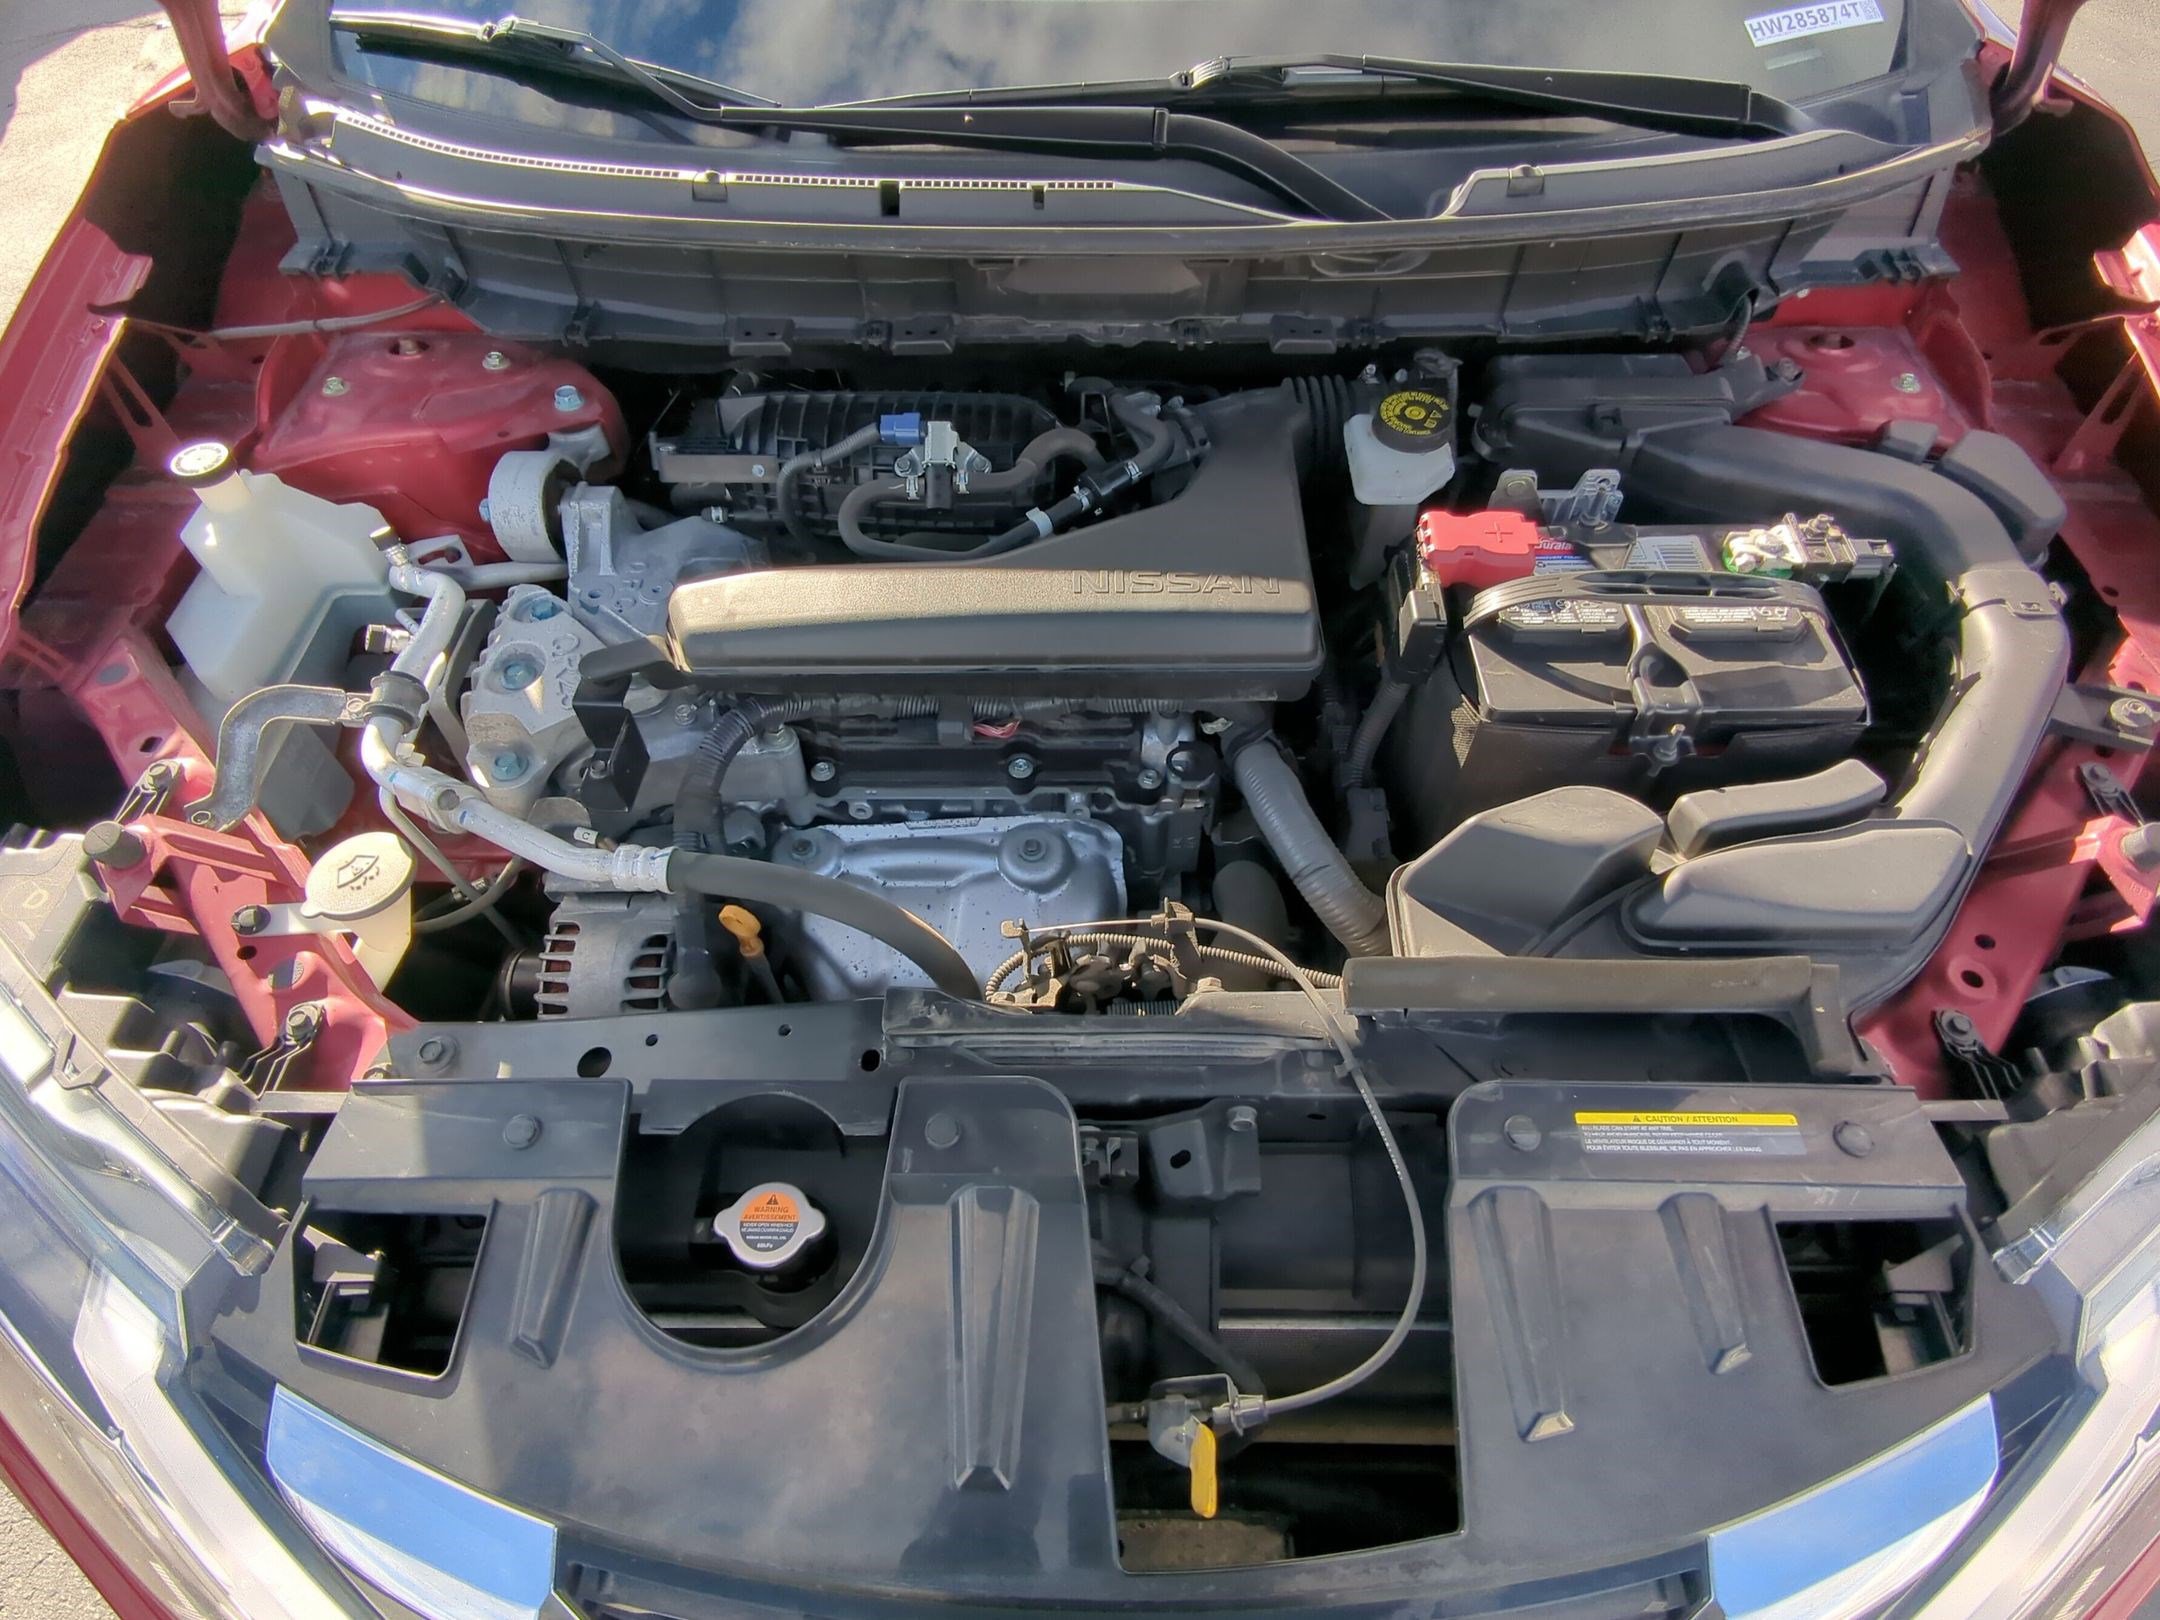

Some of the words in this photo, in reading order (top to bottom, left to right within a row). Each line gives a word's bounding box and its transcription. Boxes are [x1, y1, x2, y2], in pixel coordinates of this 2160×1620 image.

[1749, 2, 1860, 39] HW285874T
[1072, 569, 1281, 595] NISSAN
[1646, 1115, 1684, 1124] CAUTION
[1692, 1115, 1739, 1124] ATTENTION
